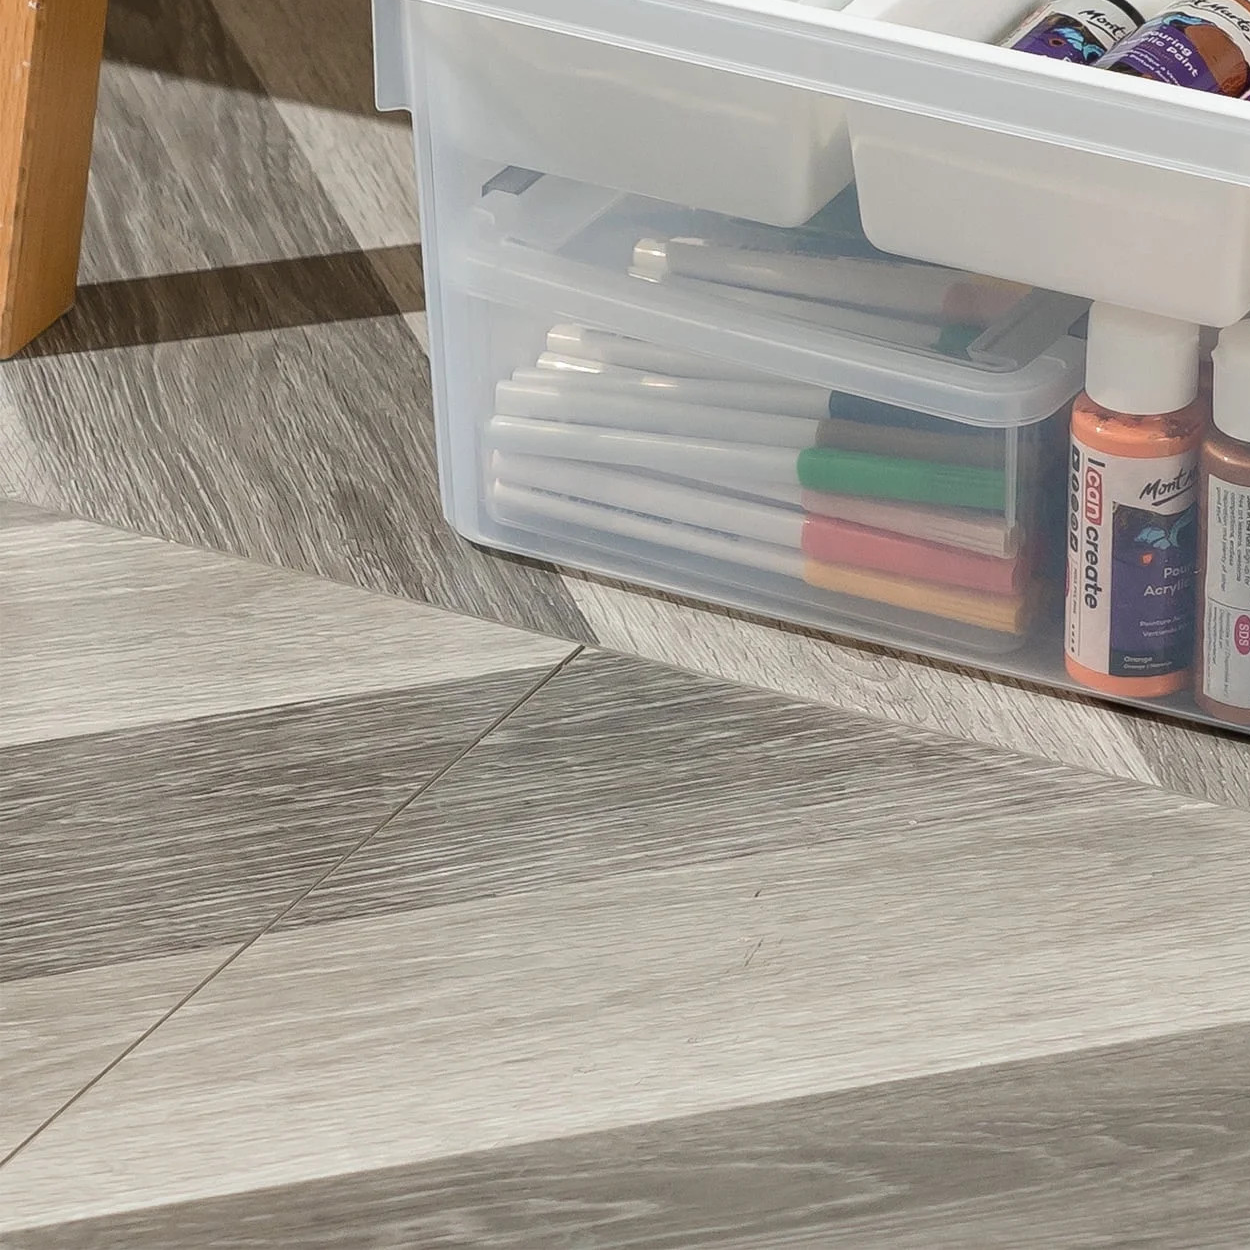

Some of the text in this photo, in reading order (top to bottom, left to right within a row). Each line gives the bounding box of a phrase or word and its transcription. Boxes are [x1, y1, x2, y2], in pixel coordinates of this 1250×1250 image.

[1078, 10, 1125, 37] Mont
[1166, 45, 1199, 78] Paint
[1086, 470, 1101, 520] can
[1139, 469, 1183, 499] Mont
[1084, 526, 1102, 609] create
[1238, 623, 1250, 646] SDS
